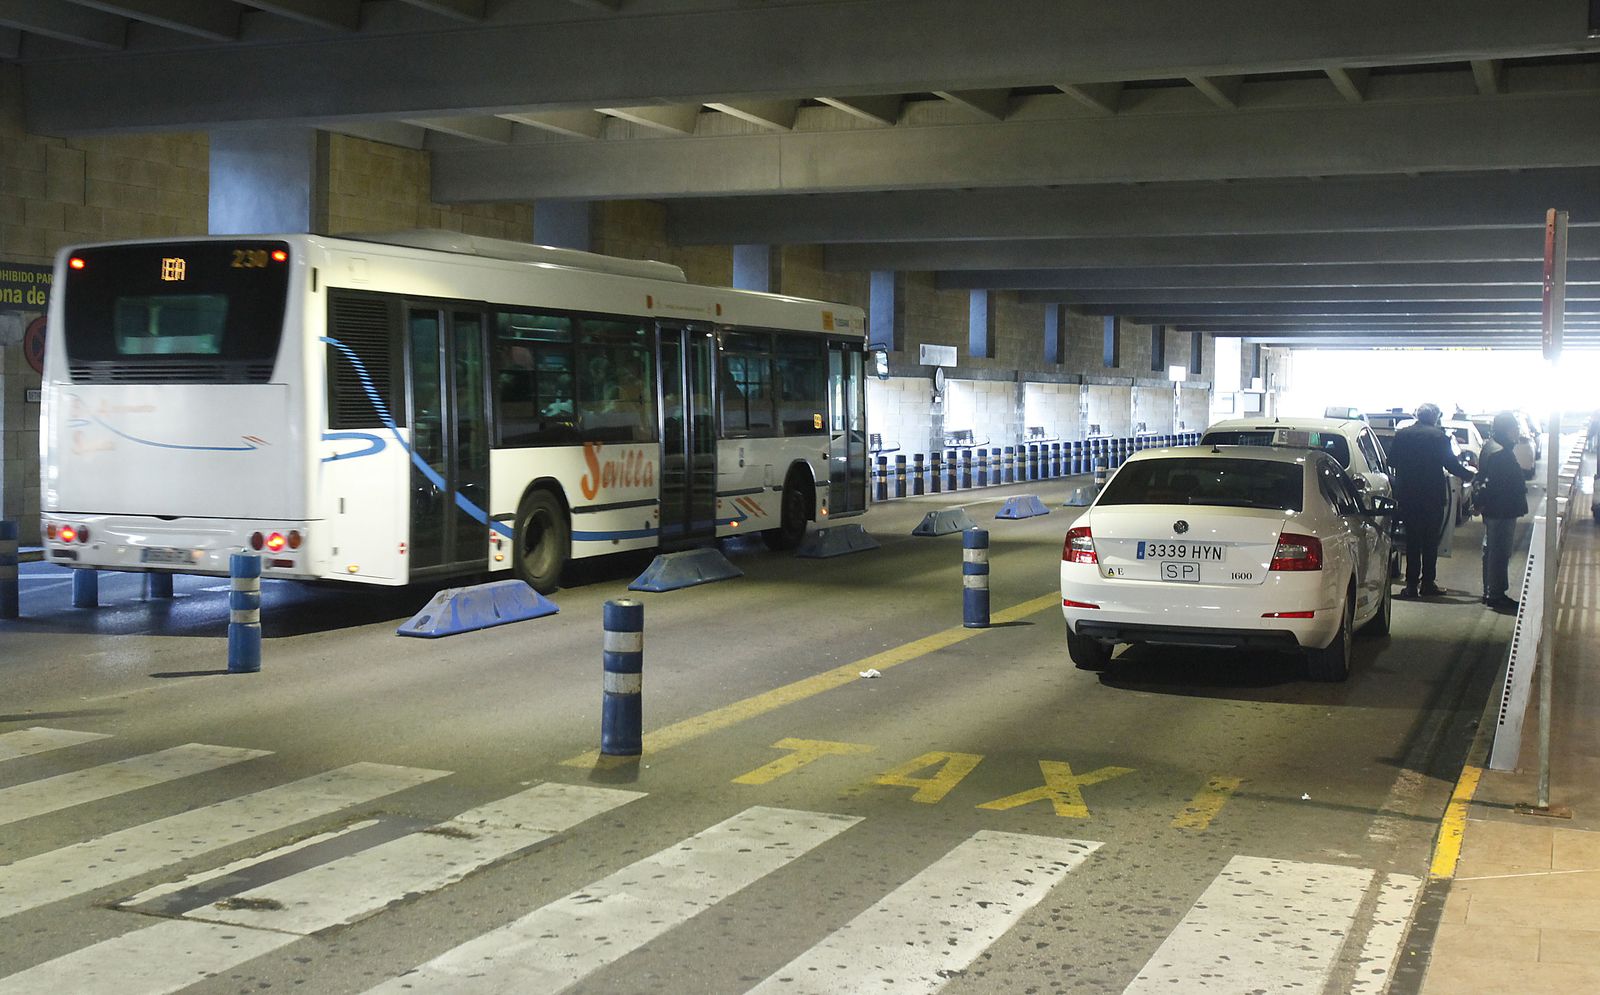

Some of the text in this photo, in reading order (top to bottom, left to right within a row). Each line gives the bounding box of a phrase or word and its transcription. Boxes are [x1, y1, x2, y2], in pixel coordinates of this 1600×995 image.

[0, 270, 34, 283] HIBIDO
[27, 285, 46, 305] de
[580, 441, 654, 500] Sevilla
[1148, 544, 1187, 558] 3339
[1192, 545, 1222, 560] HYN
[1231, 572, 1253, 581] 1600
